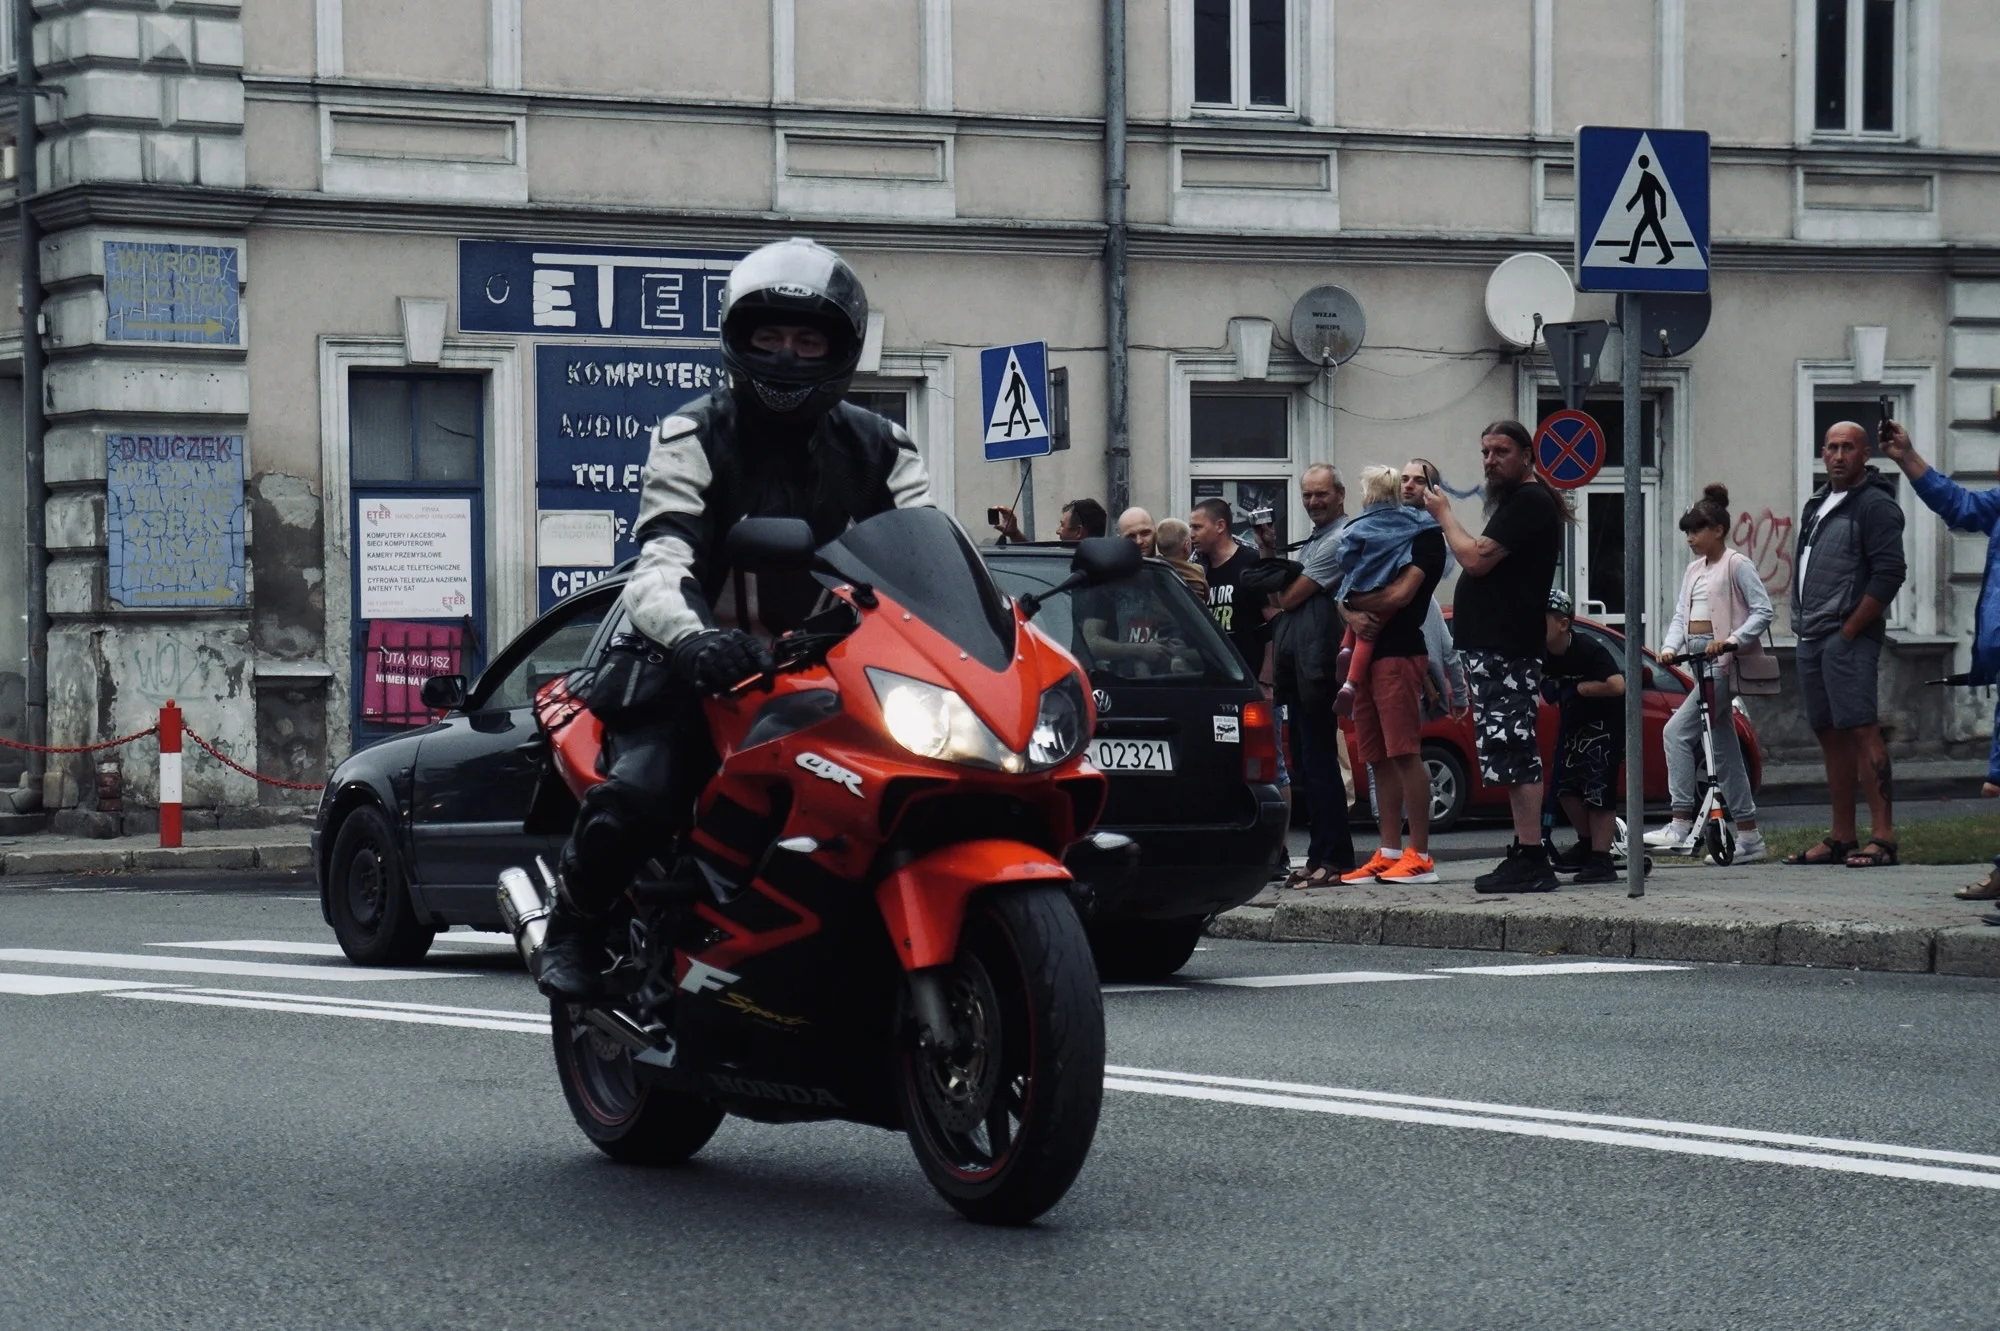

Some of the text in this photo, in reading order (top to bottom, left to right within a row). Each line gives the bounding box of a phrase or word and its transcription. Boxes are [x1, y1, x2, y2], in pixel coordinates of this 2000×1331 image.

[117, 248, 220, 277] WYRÓB
[120, 436, 231, 461] DRUCZEK
[572, 463, 645, 492] TELE
[367, 511, 391, 519] ETER
[442, 596, 465, 605] ETER
[1218, 585, 1234, 604] OR
[412, 654, 451, 669] KUPISZ
[408, 676, 420, 686] NA
[1099, 742, 1167, 770] 02321
[796, 752, 866, 799] CBR
[717, 992, 812, 1025] Sport
[707, 1072, 848, 1109] HONDA
